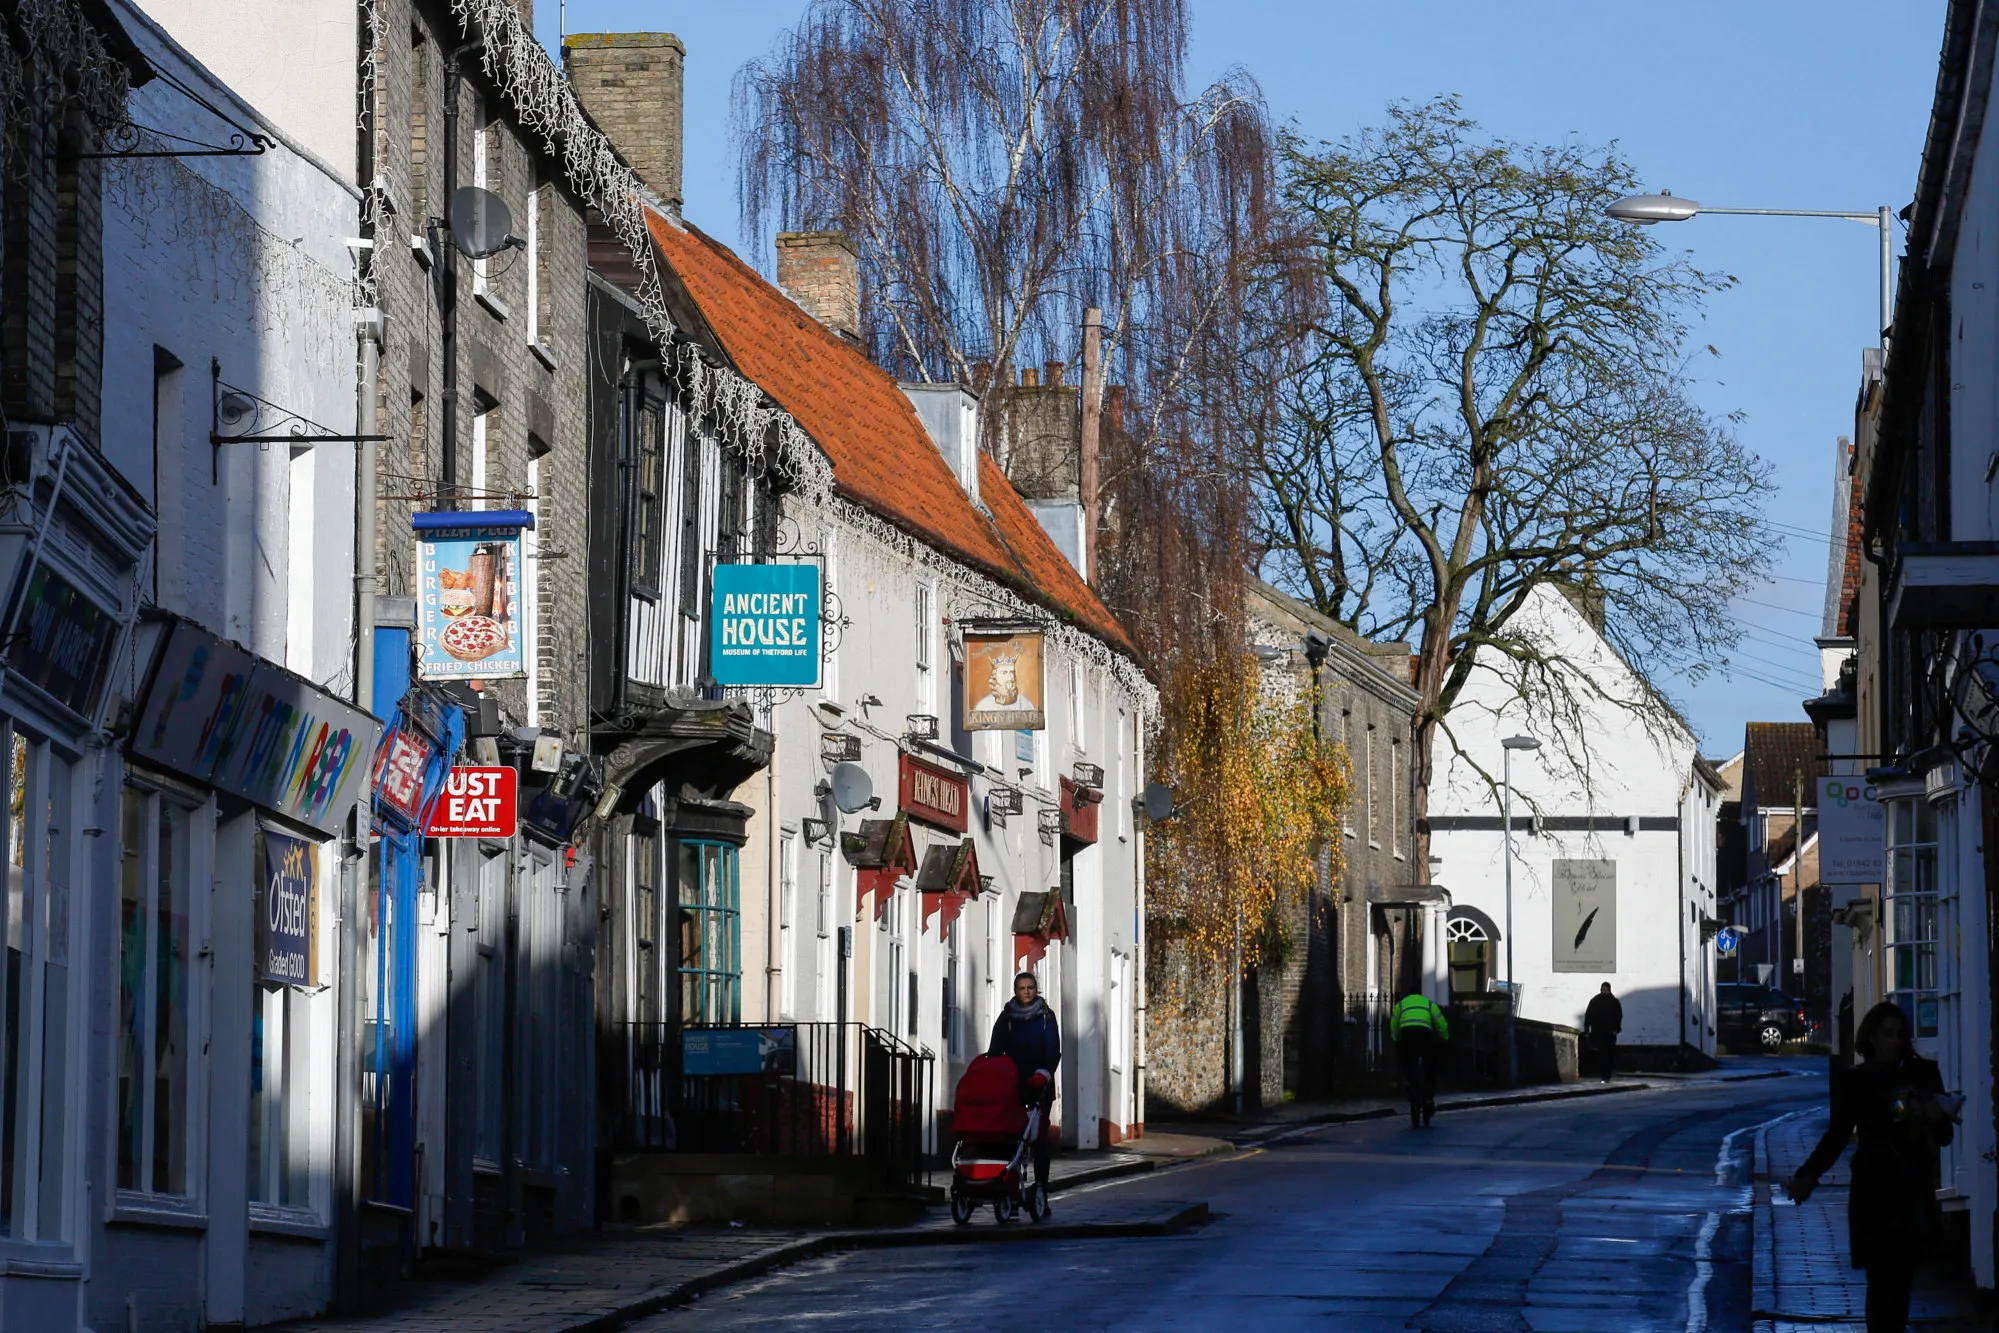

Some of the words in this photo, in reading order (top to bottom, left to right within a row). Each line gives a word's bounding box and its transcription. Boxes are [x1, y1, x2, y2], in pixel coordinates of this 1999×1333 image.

[425, 543, 437, 656] BURGERS
[506, 542, 518, 655] KEBABS
[723, 593, 808, 615] ANCIENT
[722, 618, 808, 645] HOUSE
[425, 662, 463, 673] FRIED
[467, 660, 520, 672] CHICKEN
[722, 648, 751, 656] MUSEUM
[752, 648, 761, 656] OF
[762, 648, 793, 656] THETFORD
[277, 711, 363, 818] NURSERY
[449, 798, 501, 822] EAT
[940, 780, 960, 815] HEAD
[480, 825, 501, 833] online
[269, 869, 307, 938] Ofsted
[268, 948, 289, 977] Graded
[288, 951, 305, 979] GOOD
